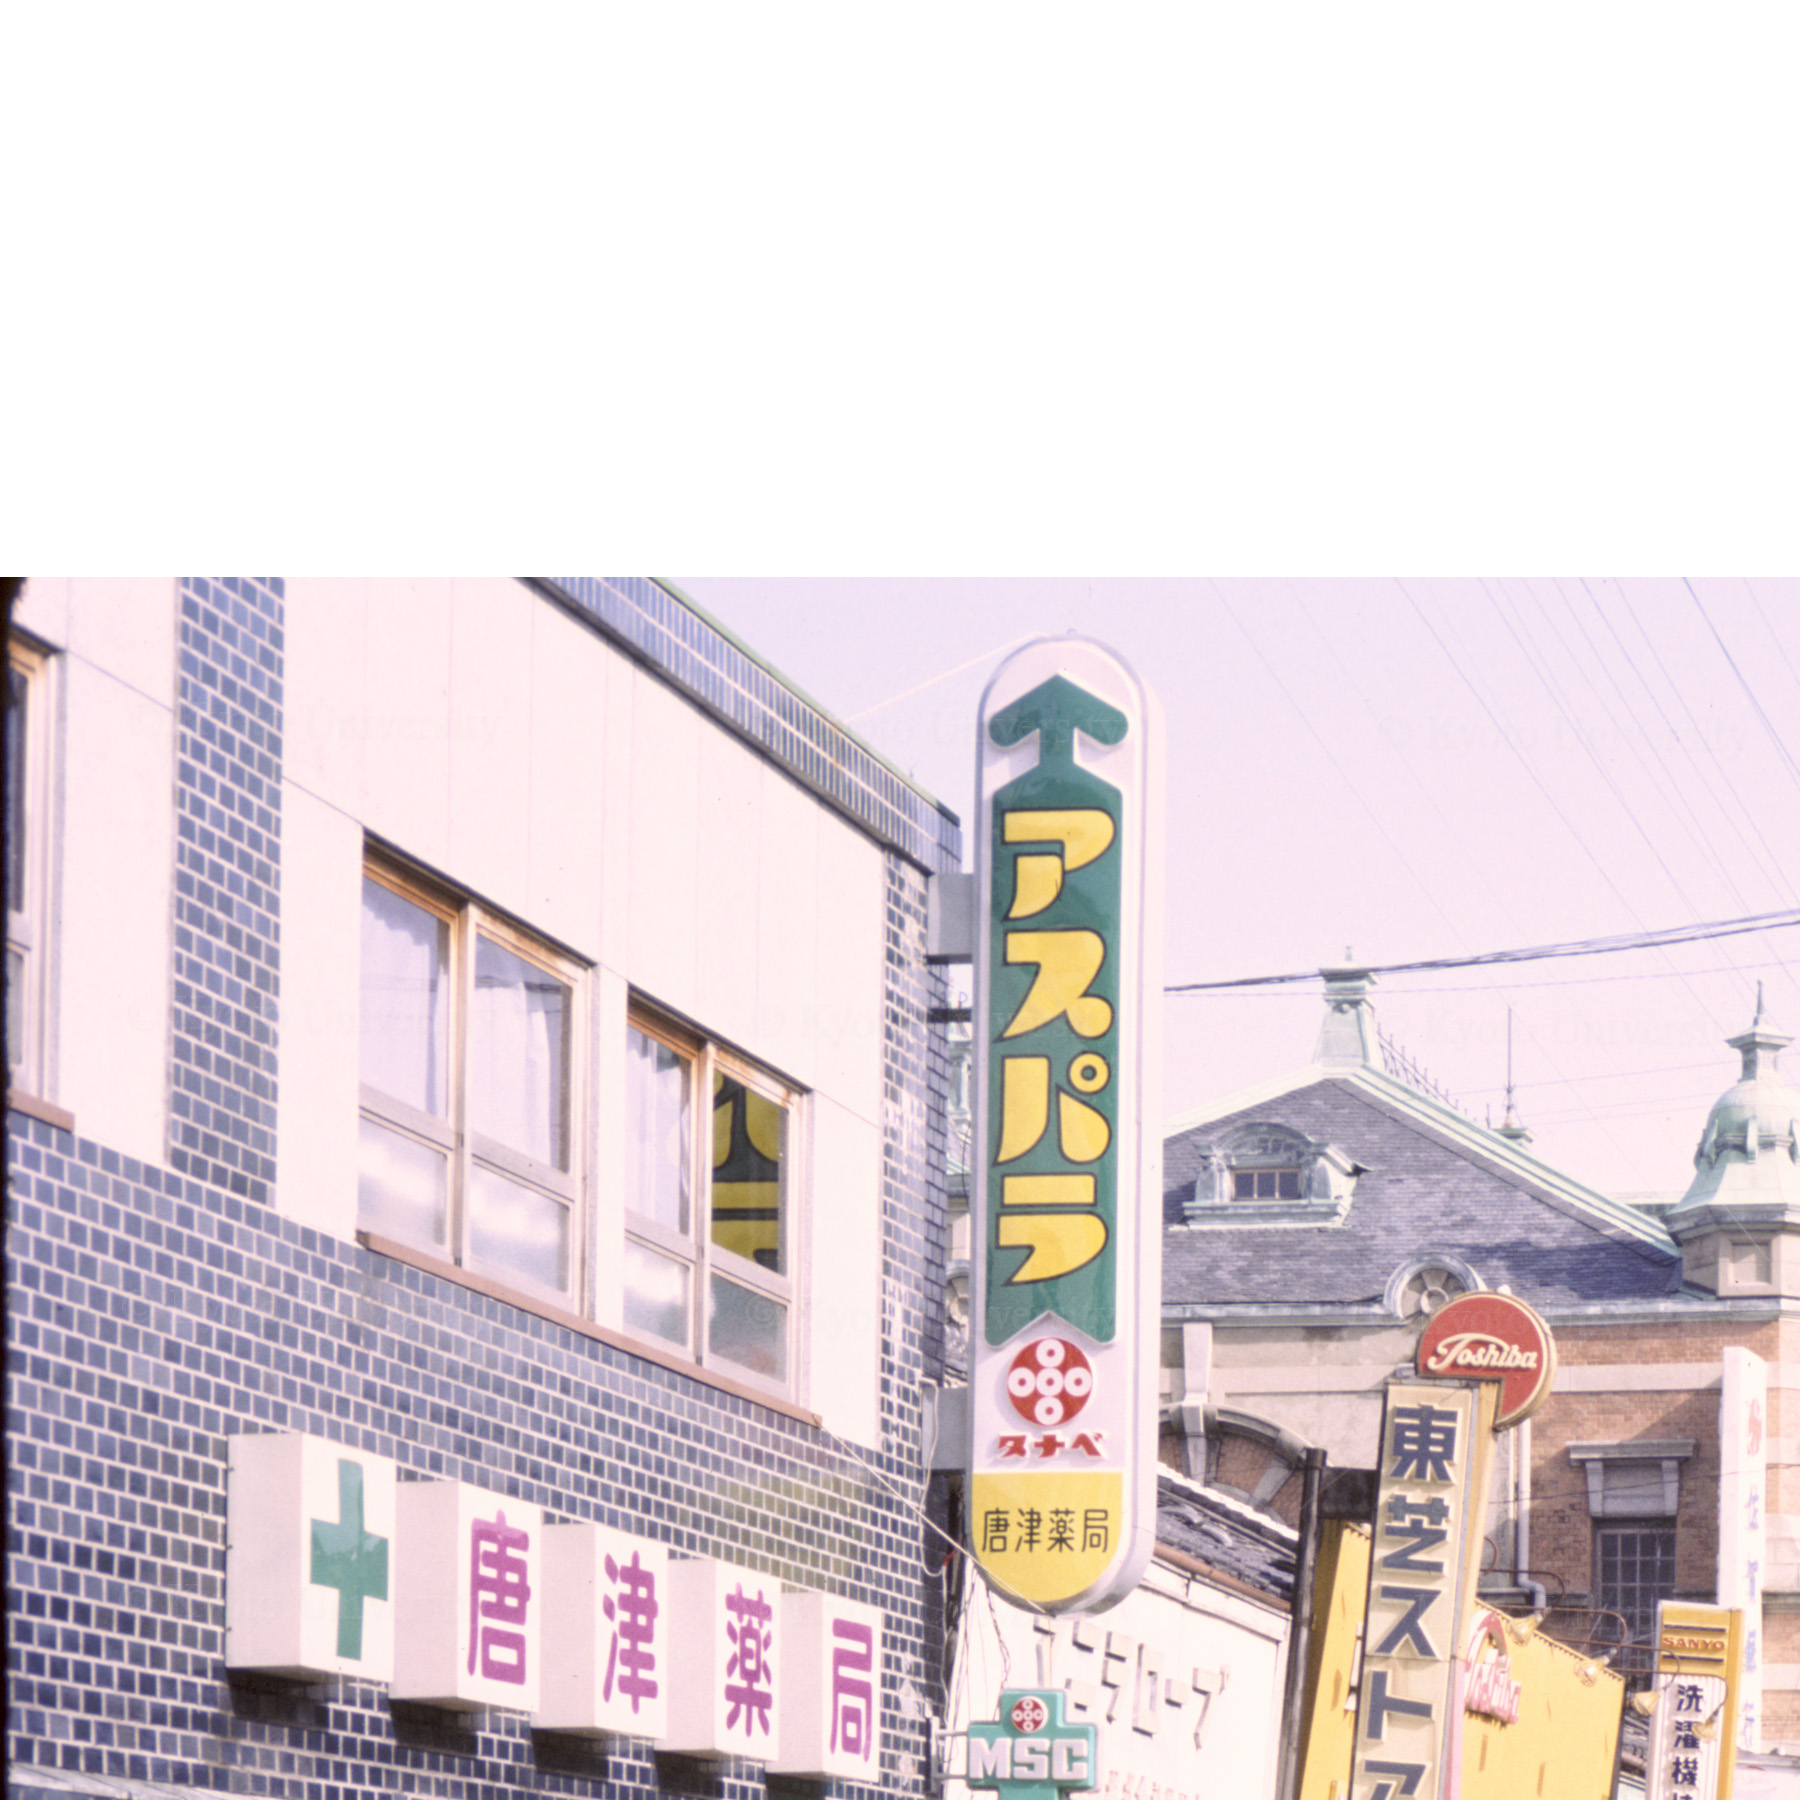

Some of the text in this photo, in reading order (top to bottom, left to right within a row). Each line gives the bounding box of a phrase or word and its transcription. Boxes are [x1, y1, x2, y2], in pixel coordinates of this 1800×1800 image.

[993, 808, 1116, 1287] アスパラ
[1427, 1331, 1539, 1371] Toshiba
[997, 1431, 1104, 1459] タナベ
[981, 1507, 1109, 1554] 唐津薬局
[467, 1509, 875, 1763] 唐津薬局
[1661, 1635, 1726, 1653] SANYO
[969, 1738, 1089, 1780] MSC
